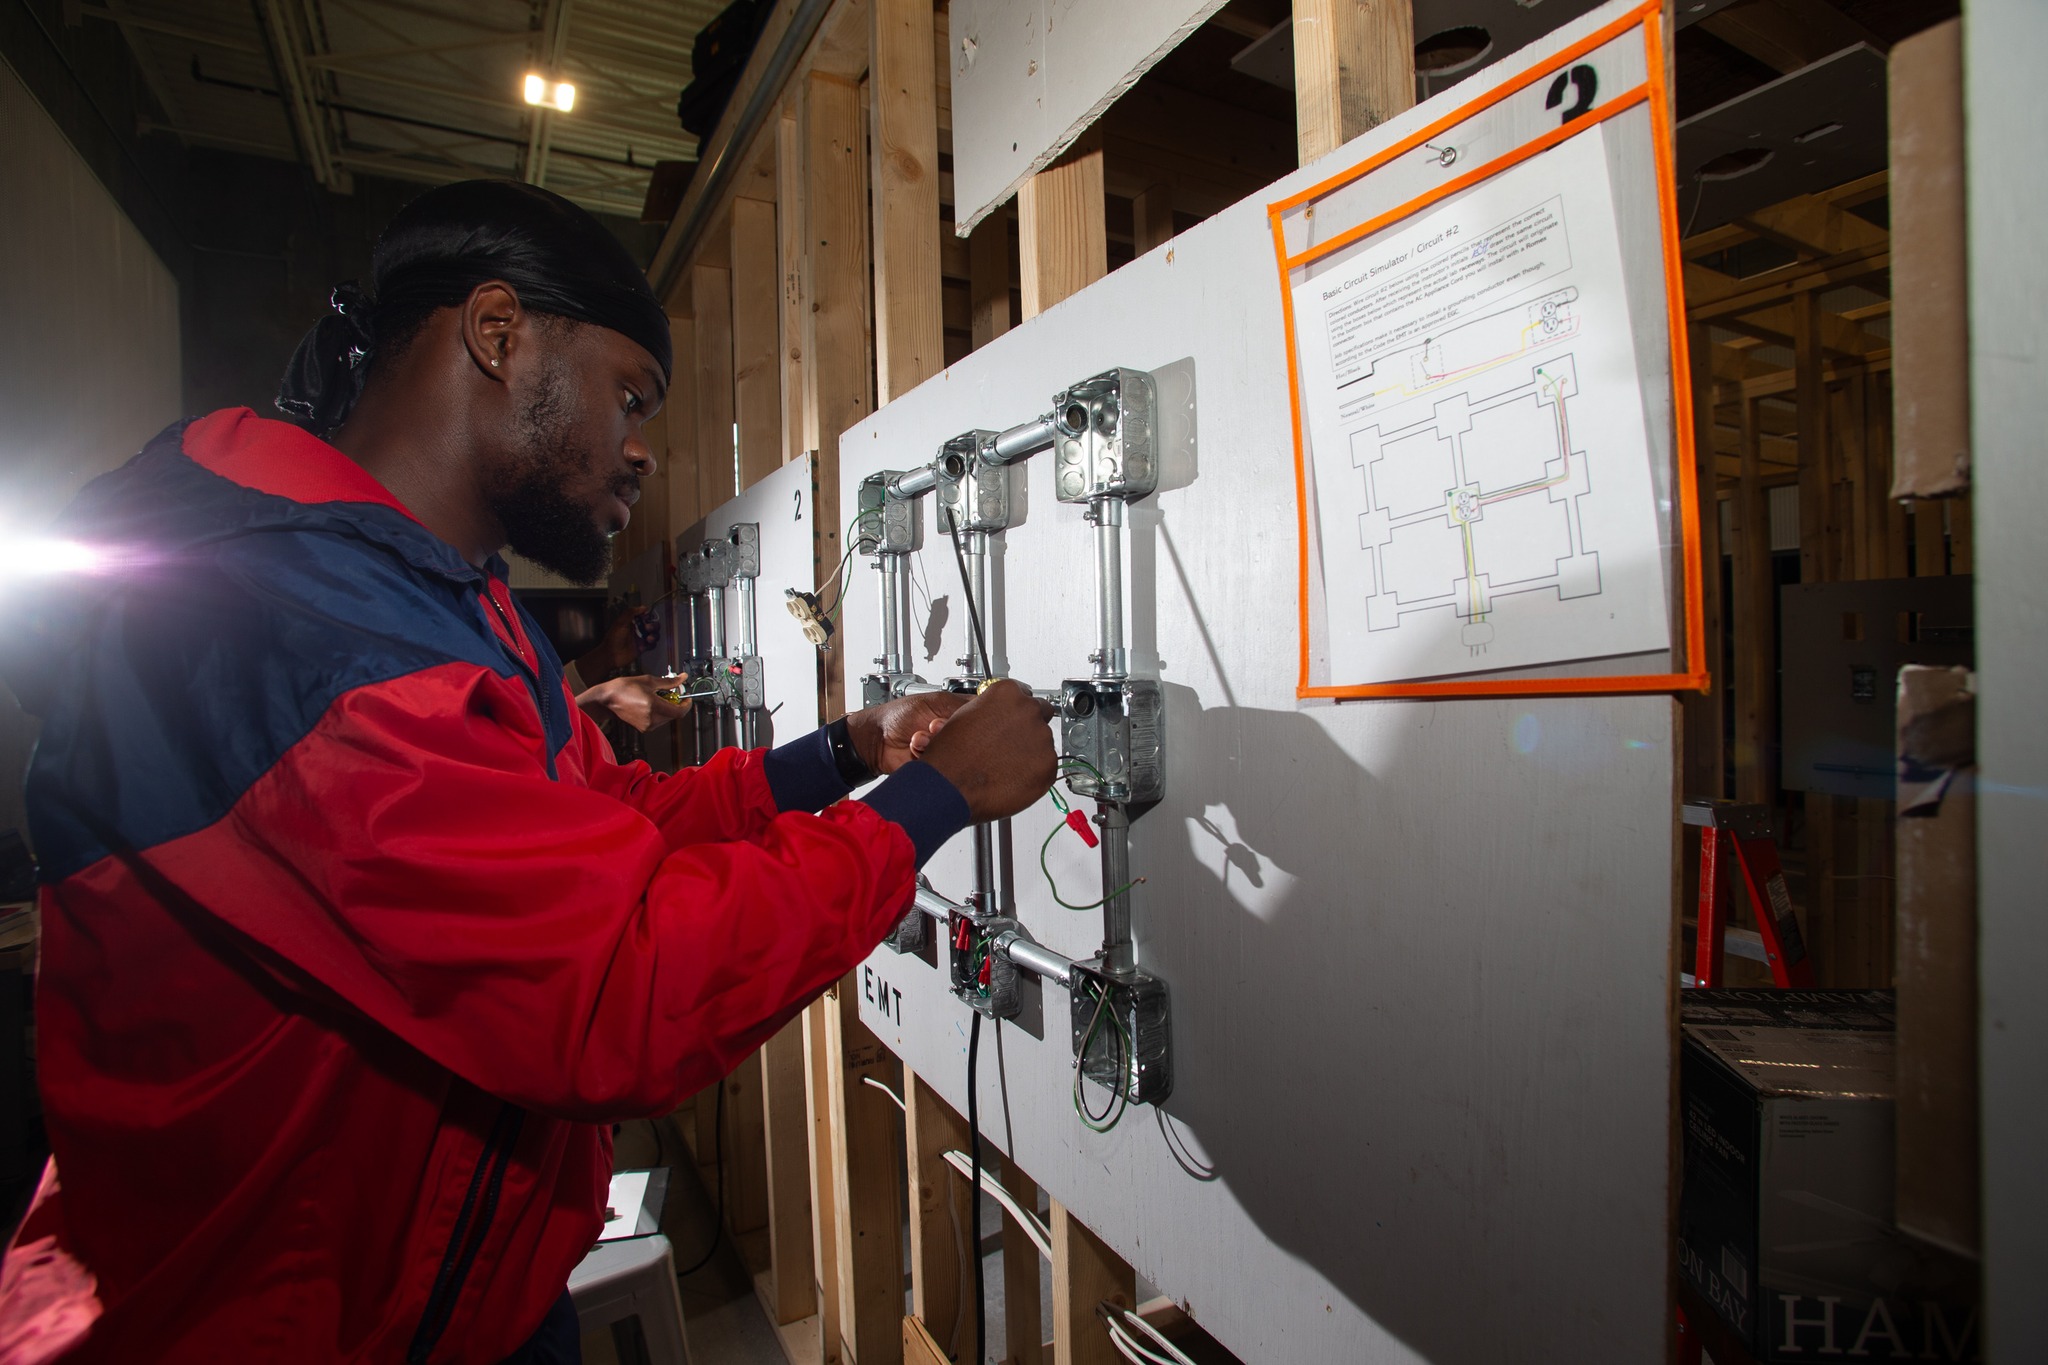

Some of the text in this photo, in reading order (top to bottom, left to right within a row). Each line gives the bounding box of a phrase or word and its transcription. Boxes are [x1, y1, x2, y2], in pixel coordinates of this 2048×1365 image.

[1322, 286, 1342, 301] Basic
[1344, 273, 1368, 290] Circuit
[1369, 252, 1408, 278] Simulator
[1416, 234, 1444, 254] Circuit
[1446, 225, 1459, 238] #2
[1353, 298, 1364, 306] Wire
[1365, 291, 1380, 301] circuit
[1389, 280, 1404, 289] below
[1405, 272, 1419, 283] using
[1430, 256, 1449, 269] colored
[1450, 246, 1469, 260] pencils
[1470, 240, 1482, 249] that
[1485, 224, 1511, 242] represent
[1524, 208, 1545, 222] correct
[1489, 239, 1504, 249] draw
[1517, 224, 1532, 235] same
[1534, 213, 1553, 227] circuit
[1329, 314, 1346, 325] colored
[1375, 296, 1387, 304] After
[1388, 284, 1411, 297] receiving
[1412, 279, 1420, 287] the
[1451, 256, 1468, 267] initials
[1337, 330, 1345, 338] the
[1346, 323, 1363, 334] bottom
[1373, 313, 1383, 321] that
[1384, 304, 1405, 317] contains
[1406, 299, 1414, 307] the
[1424, 282, 1450, 298] Appliance
[1450, 275, 1464, 285] Cord
[1465, 271, 1476, 280] you
[1477, 265, 1486, 273] will
[1488, 256, 1505, 267] install
[1506, 250, 1519, 258] with
[1526, 236, 1547, 249] Romex
[1353, 314, 1366, 323] boxes
[1368, 306, 1382, 316] below
[1383, 299, 1397, 308] which
[1398, 288, 1422, 302] represent
[1433, 274, 1448, 285] actual
[1487, 250, 1497, 258] The
[1499, 241, 1517, 253] circuit
[1518, 235, 1529, 243] will
[1530, 221, 1558, 239] originate
[1335, 355, 1358, 366] according
[1373, 342, 1386, 350] Code
[1396, 332, 1407, 340] EMT
[1421, 314, 1446, 330] approved
[1343, 338, 1374, 355] specifications
[1375, 333, 1387, 341] make
[1393, 320, 1418, 333] necessary
[1426, 308, 1441, 319] install
[1448, 293, 1476, 310] grounding
[1477, 280, 1505, 296] conductor
[1507, 272, 1521, 282] even
[794, 489, 802, 522] 2
[864, 964, 902, 1026] EMT
[1708, 1269, 1747, 1334] BAY
